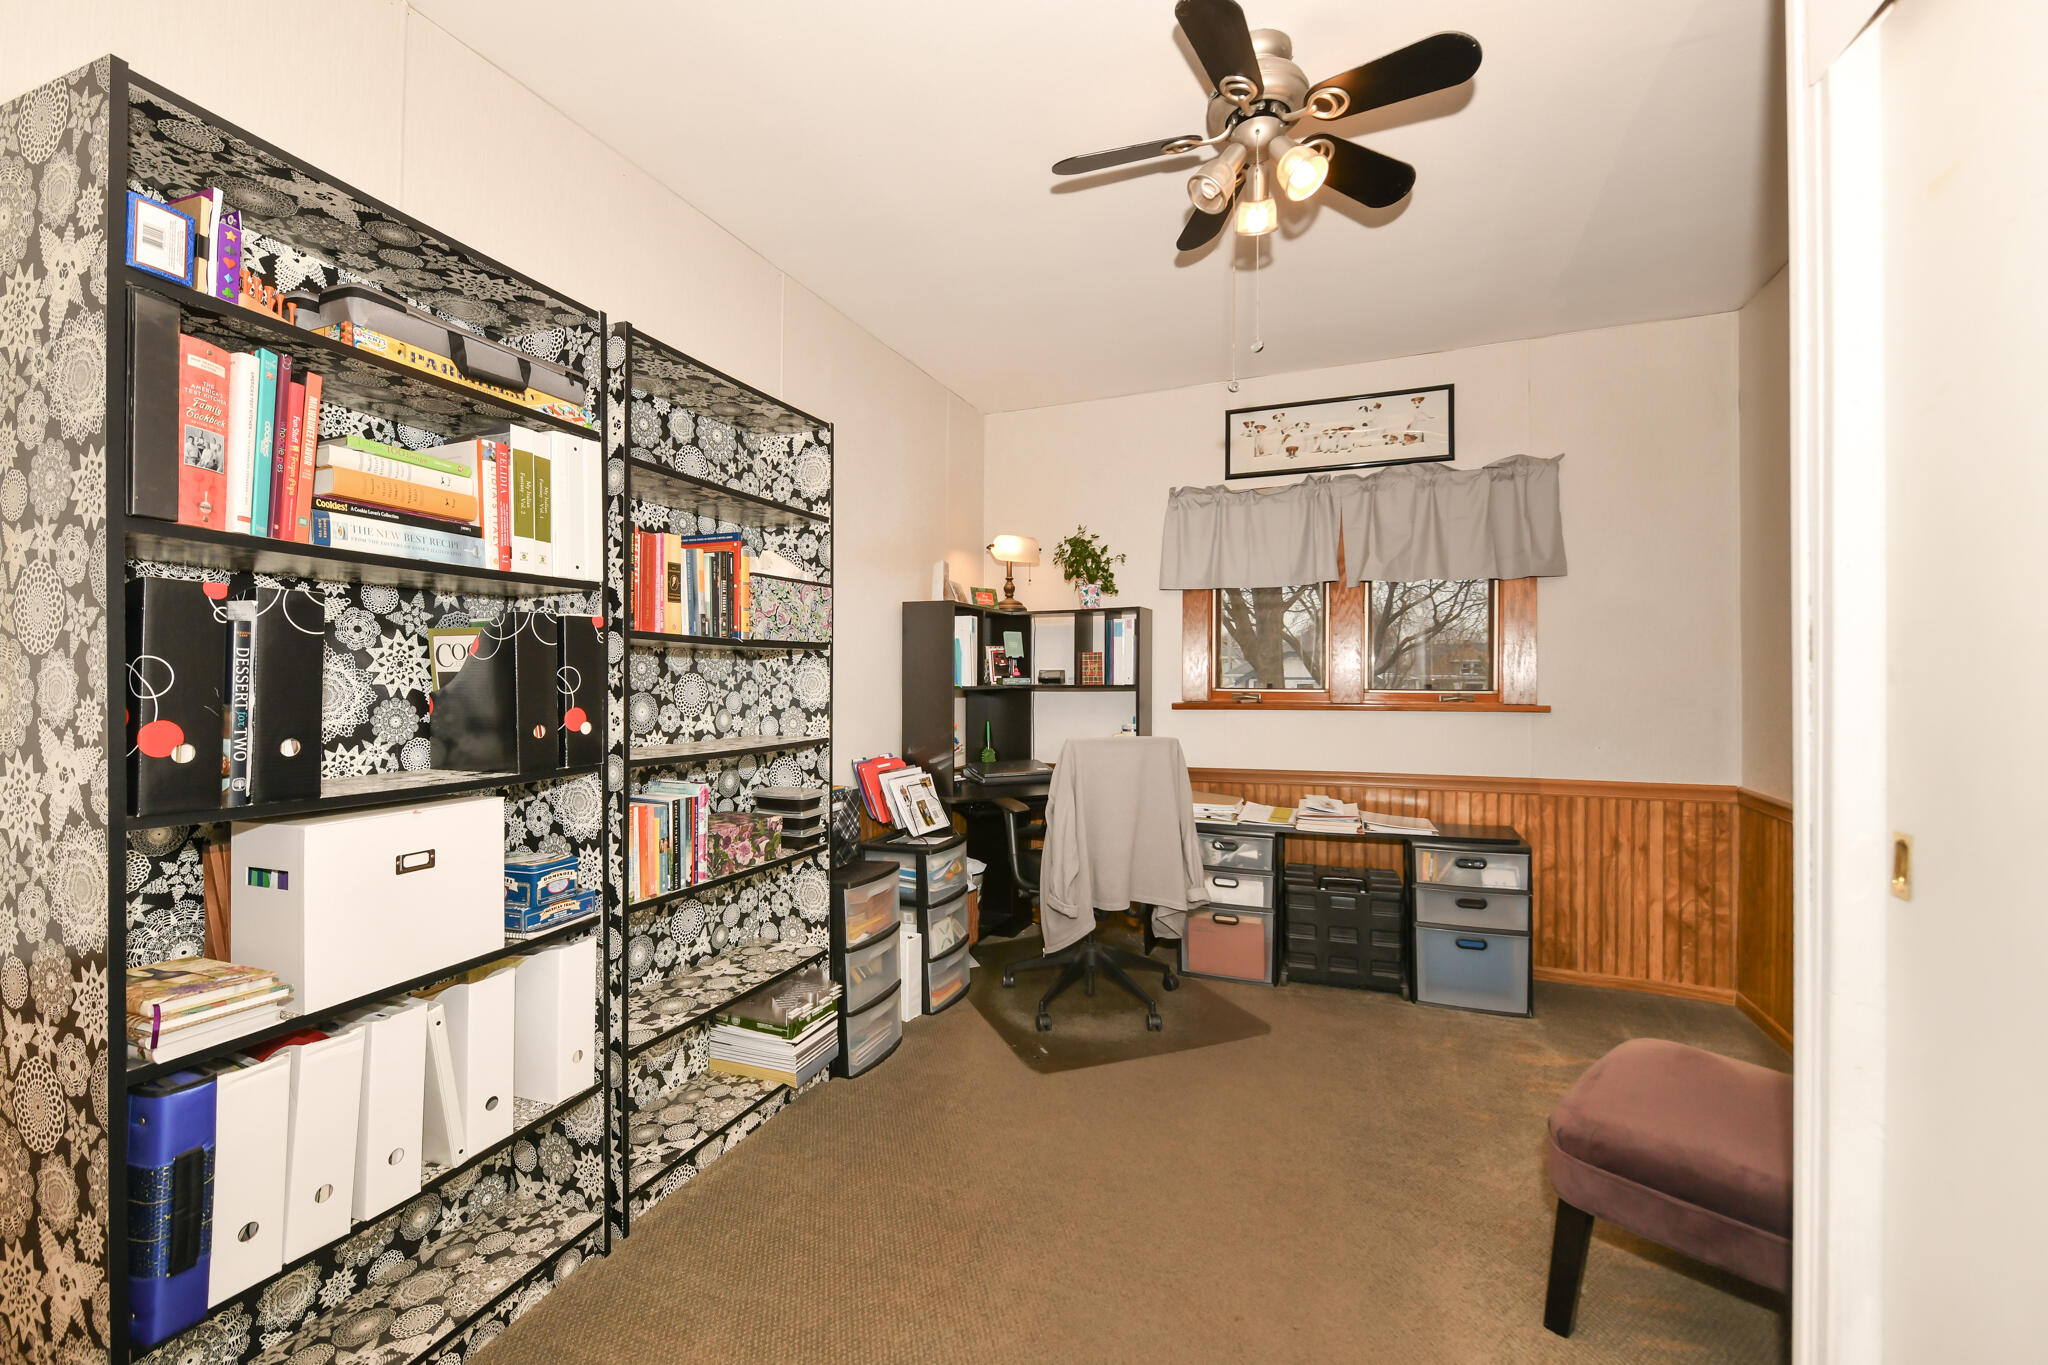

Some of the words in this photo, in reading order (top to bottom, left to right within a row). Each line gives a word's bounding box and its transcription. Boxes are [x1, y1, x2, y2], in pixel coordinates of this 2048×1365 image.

[185, 387, 202, 397] TEST
[186, 406, 225, 428] Cookbook
[193, 397, 222, 417] Family
[306, 395, 318, 439] MILWAUKEE
[292, 415, 300, 428] Fun
[304, 439, 314, 466] FLAVOR
[500, 452, 508, 494] FELIDIA
[315, 498, 348, 512] Cookies!
[353, 507, 368, 515] Cookie
[380, 511, 400, 519] Collection
[351, 524, 373, 536] THE
[376, 528, 400, 539] NEW
[403, 533, 429, 544] BEST
[429, 537, 461, 550] RECIPE
[234, 646, 250, 710] DESSERT
[237, 710, 248, 728] for
[233, 727, 248, 762] TWO
